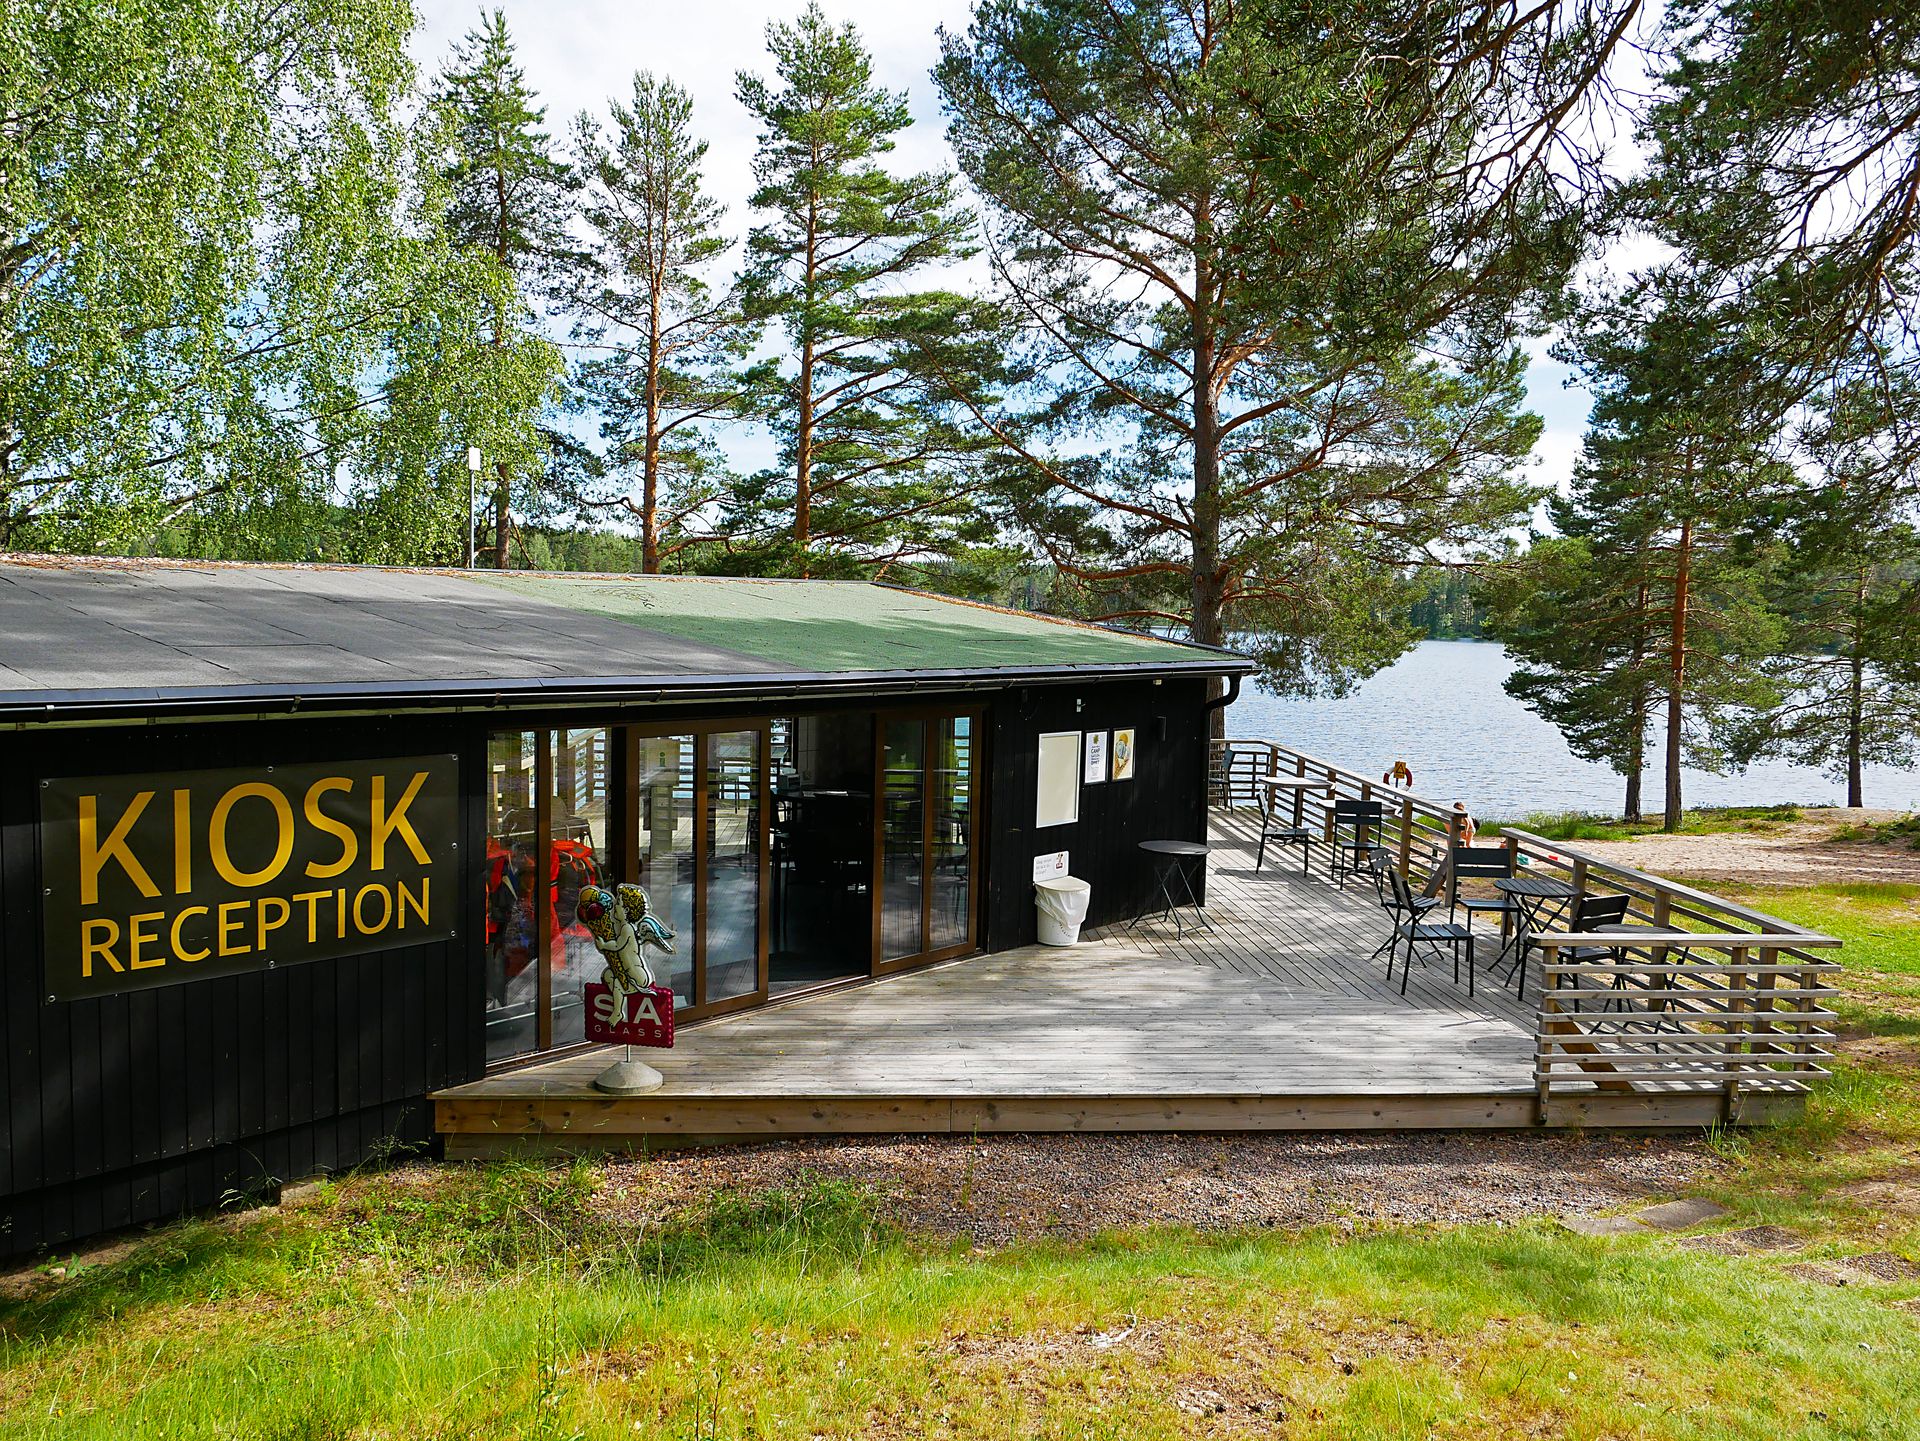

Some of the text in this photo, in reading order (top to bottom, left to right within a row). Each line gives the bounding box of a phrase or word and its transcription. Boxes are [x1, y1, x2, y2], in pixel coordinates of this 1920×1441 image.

[79, 772, 433, 905] KIOSK
[81, 877, 431, 977] RECEPTION
[593, 993, 663, 1026] SIA
[594, 1024, 662, 1038] GLASS
